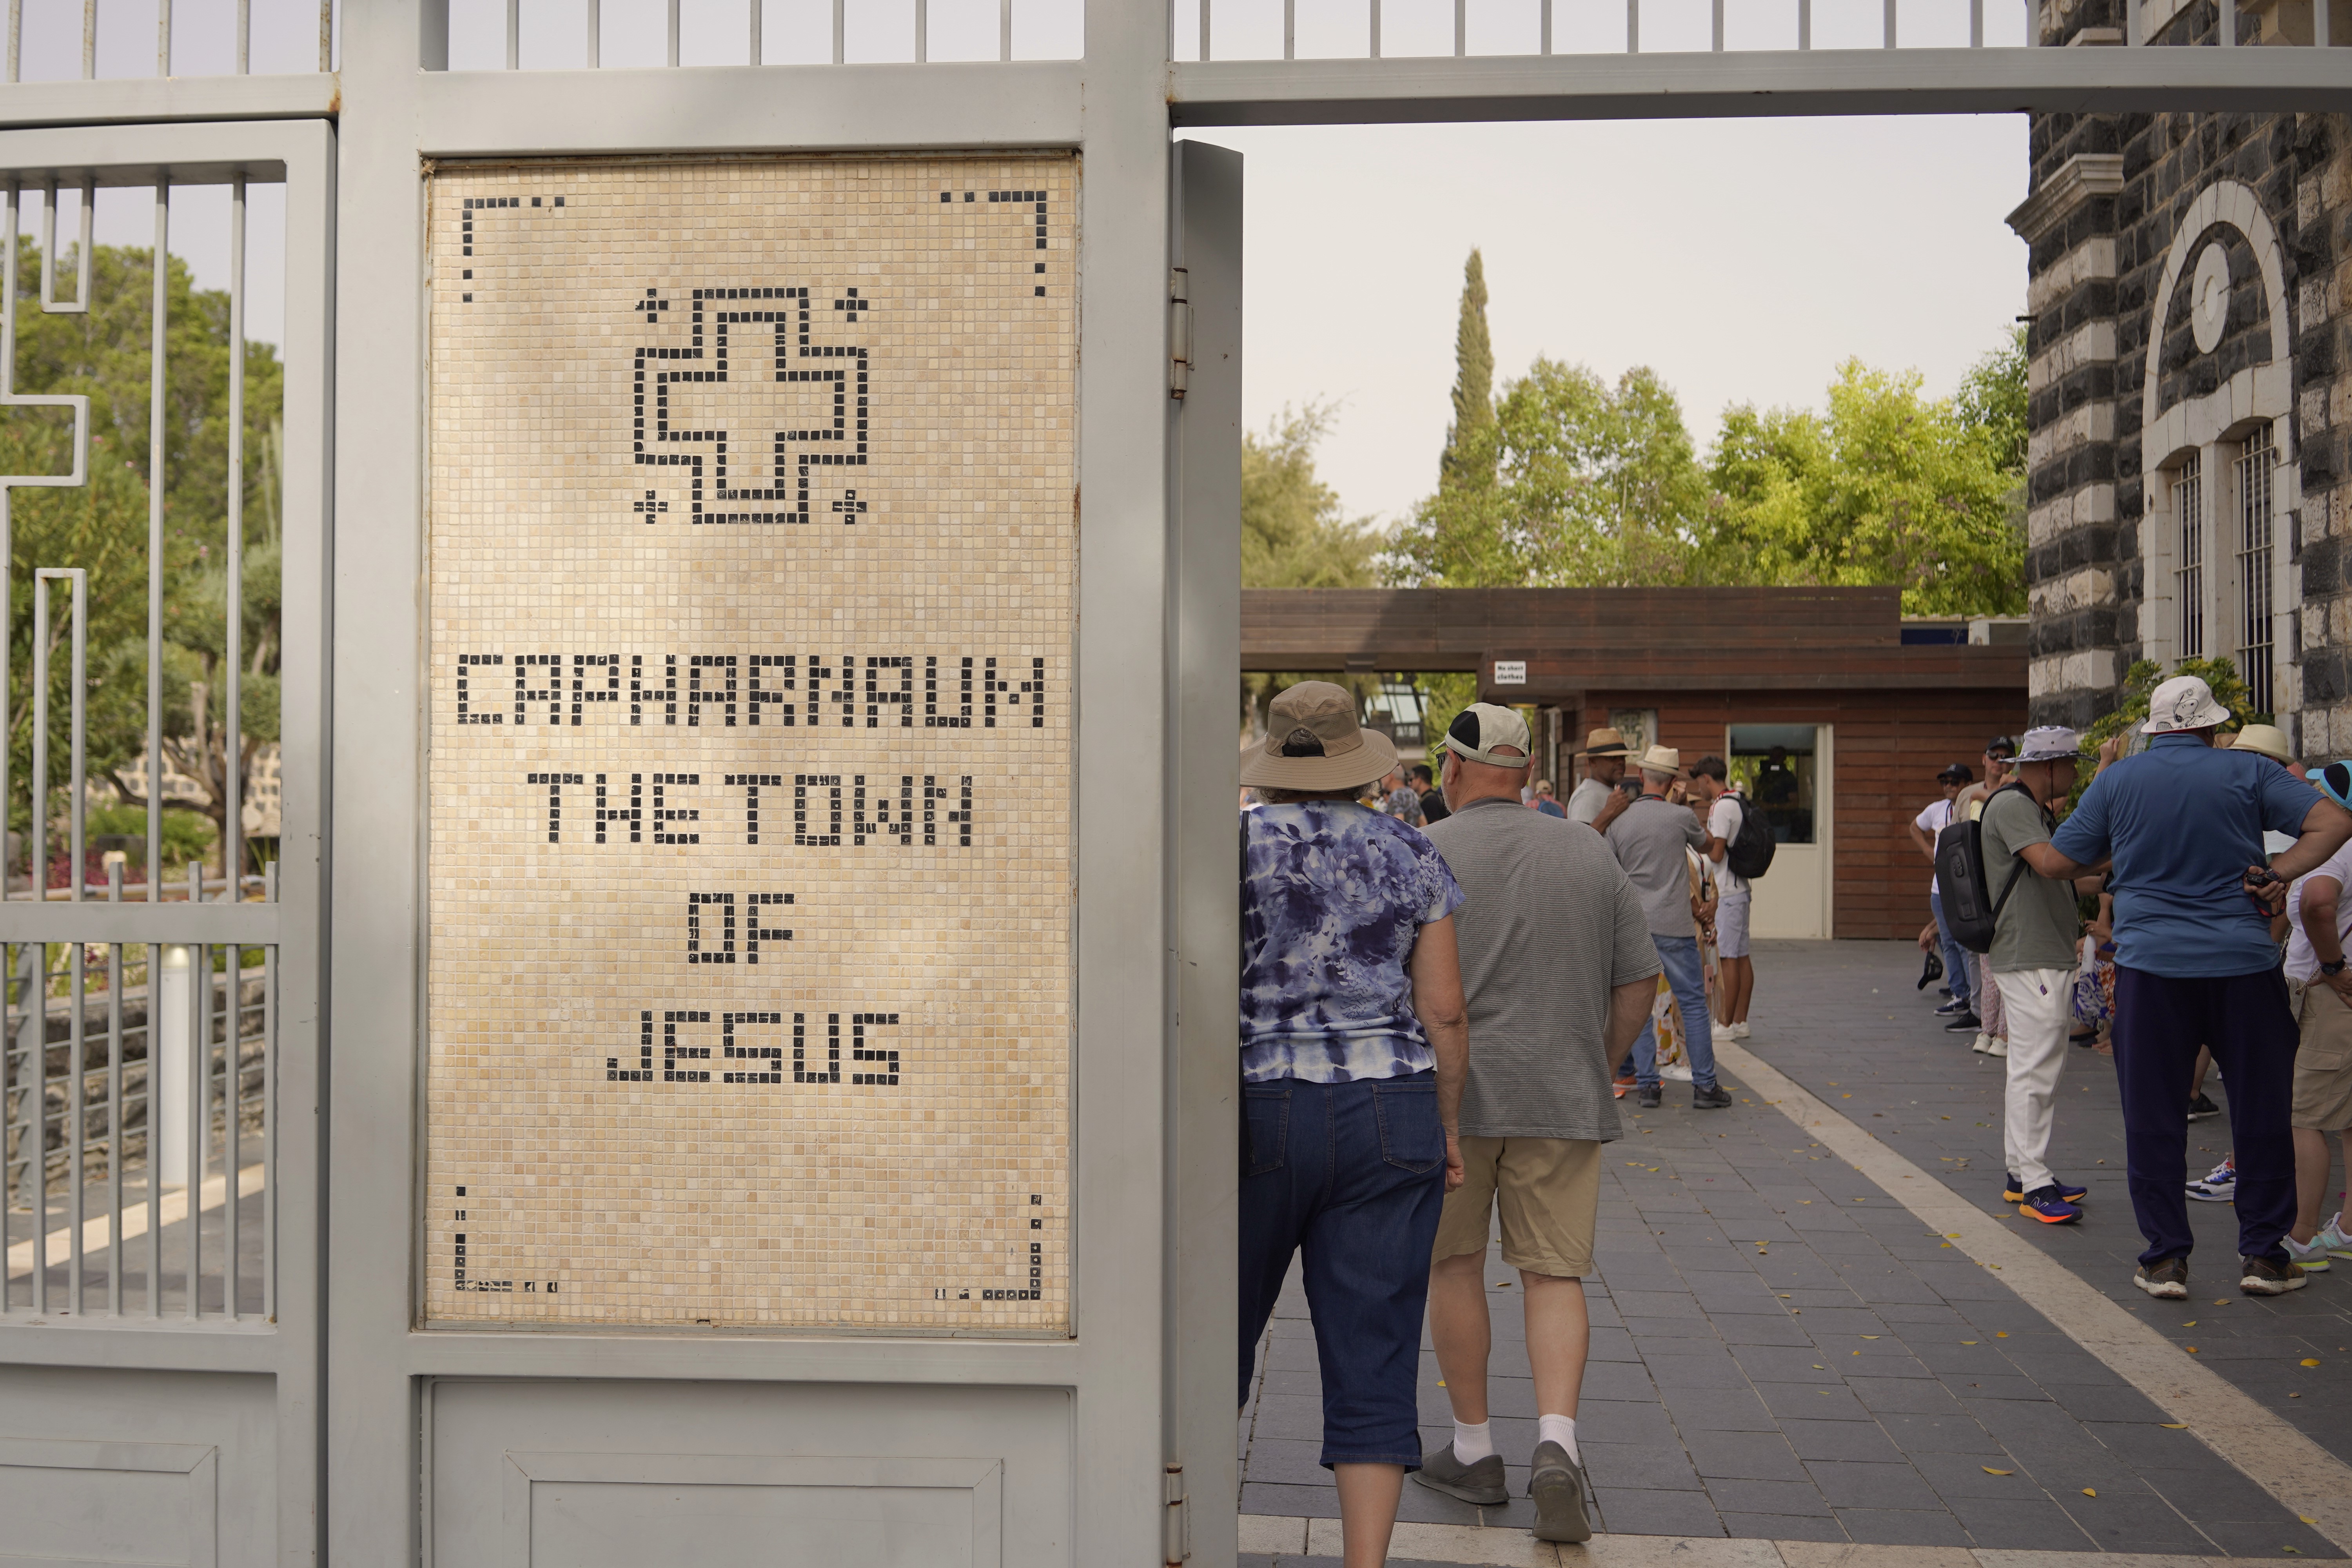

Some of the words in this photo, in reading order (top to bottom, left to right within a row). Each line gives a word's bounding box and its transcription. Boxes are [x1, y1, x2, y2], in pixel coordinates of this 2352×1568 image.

[458, 655, 1044, 728] CAPHARNAUM
[528, 774, 700, 844] THE
[725, 775, 972, 846] TOWN
[688, 893, 794, 964] OF
[607, 1011, 899, 1085] JESUS
